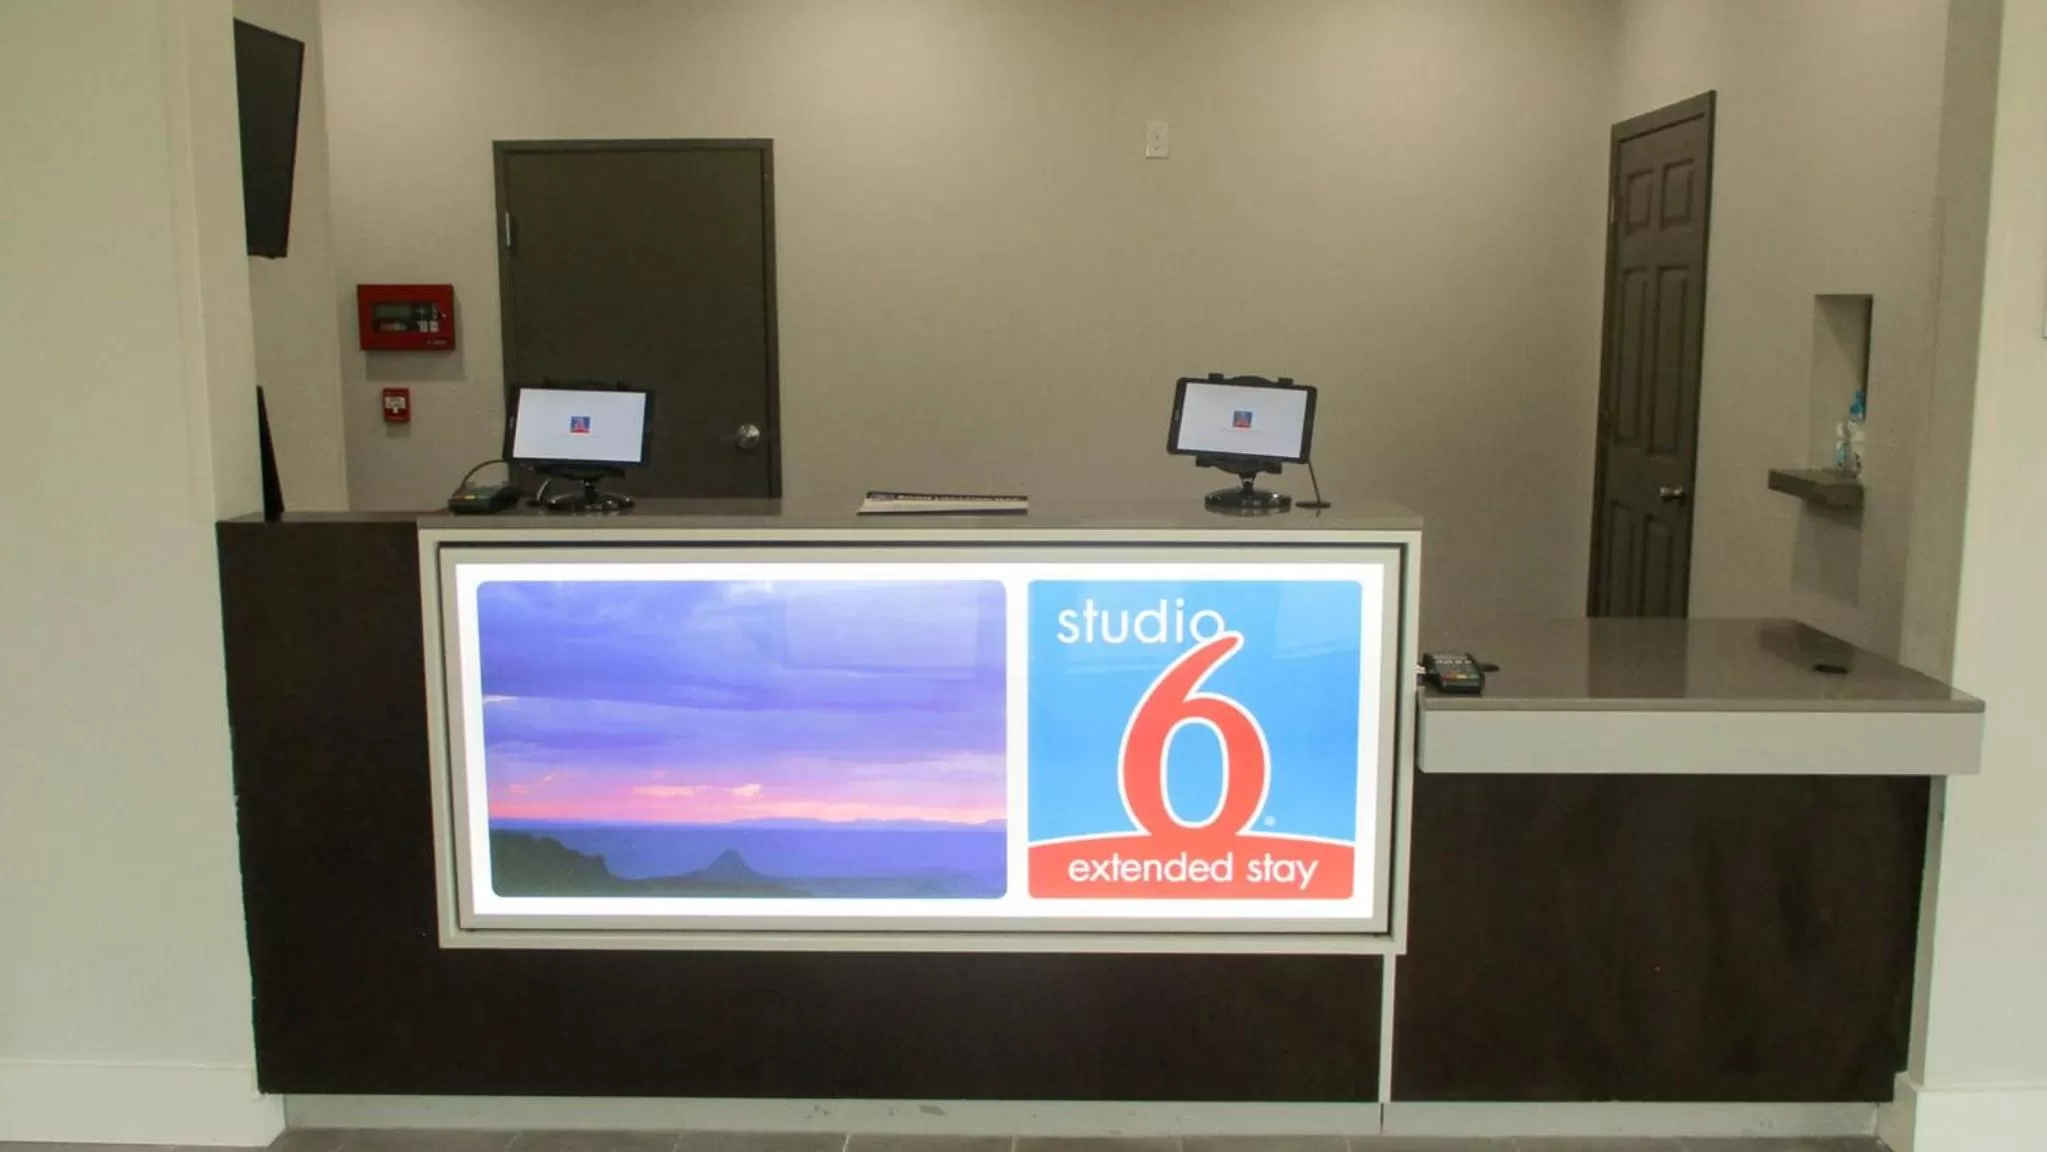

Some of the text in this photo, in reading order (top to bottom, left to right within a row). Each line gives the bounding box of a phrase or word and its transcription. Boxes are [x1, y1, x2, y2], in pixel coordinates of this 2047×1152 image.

[1057, 598, 1226, 643] studio
[1117, 630, 1271, 836] 6
[1067, 851, 1318, 891] extended stay
